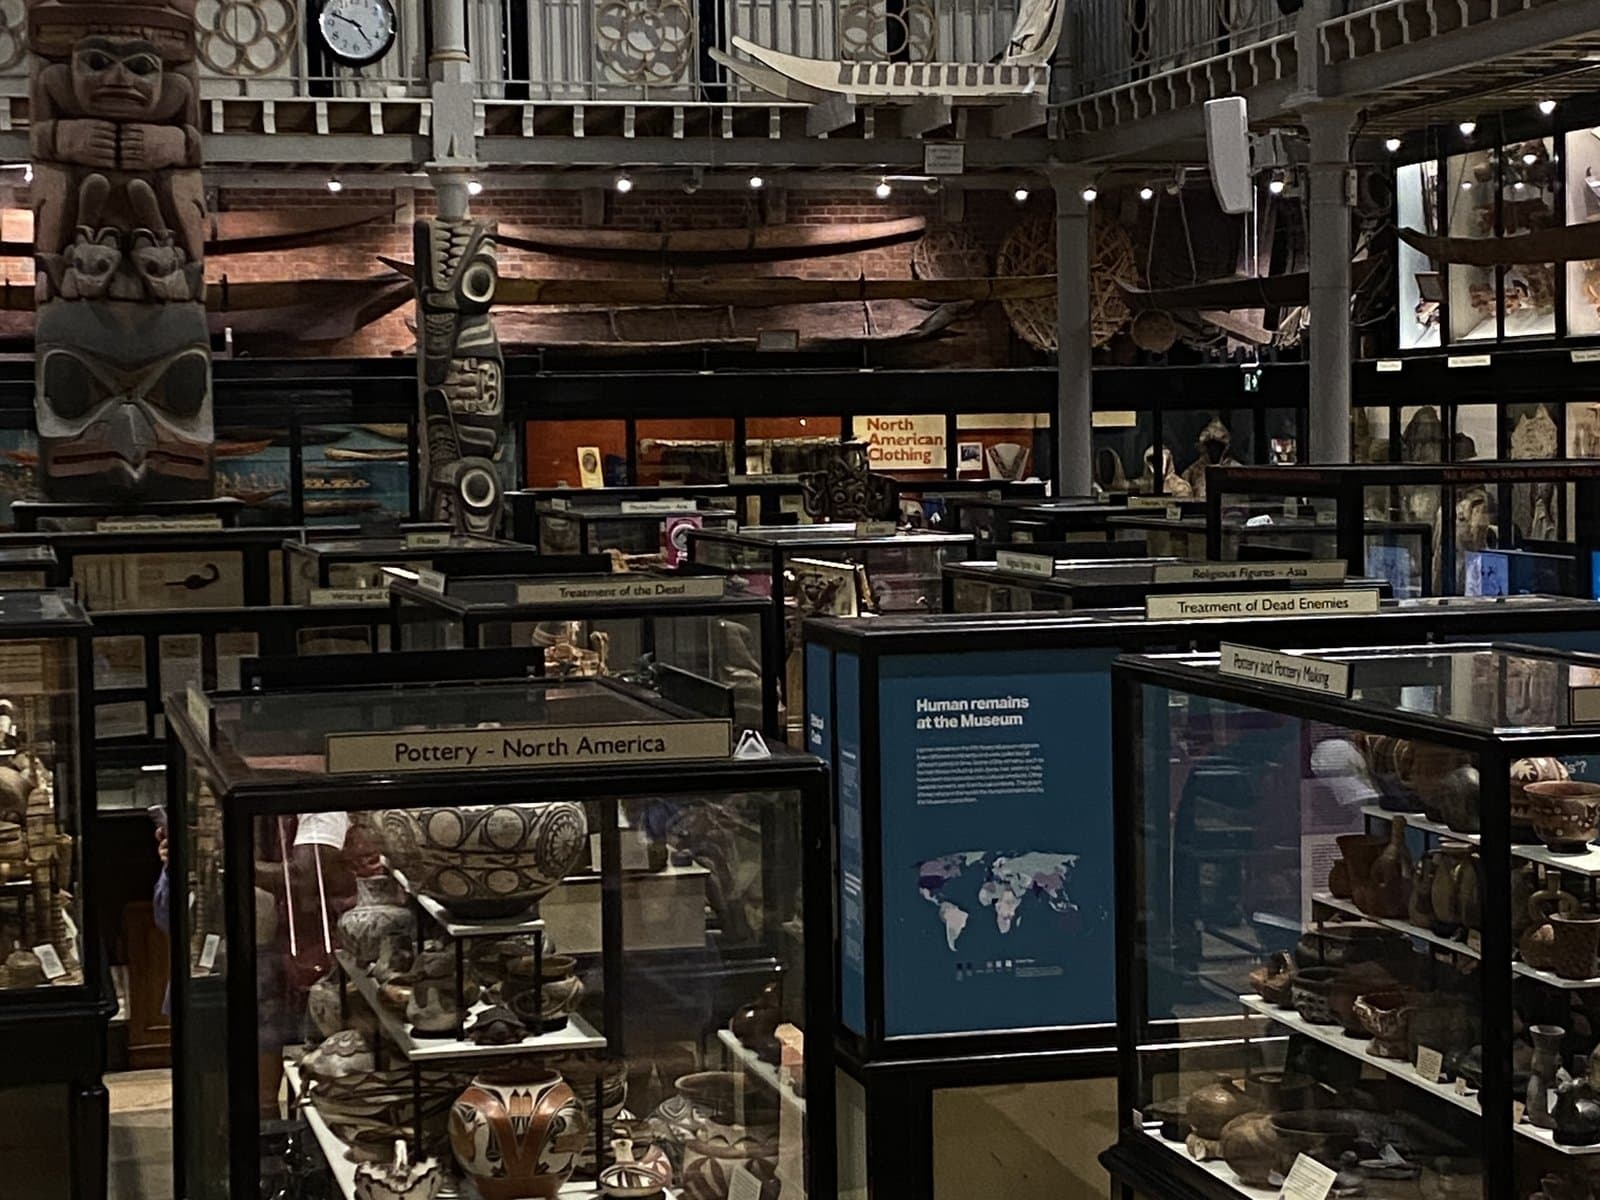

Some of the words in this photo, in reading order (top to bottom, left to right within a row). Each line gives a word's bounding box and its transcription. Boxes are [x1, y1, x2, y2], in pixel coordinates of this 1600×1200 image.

[867, 418, 914, 431] North
[869, 432, 943, 446] American
[868, 448, 932, 465] Clothing
[1240, 567, 1275, 580] Figures
[1286, 567, 1308, 577] Asia
[559, 586, 616, 598] Treatment
[619, 585, 631, 597] of
[634, 584, 651, 596] the
[655, 583, 686, 595] Dead
[1177, 600, 1242, 614] Treatment
[1245, 599, 1259, 612] of
[1262, 598, 1295, 612] Dead
[1299, 597, 1350, 611] Enemies
[1233, 653, 1259, 676] Pottery
[1260, 660, 1274, 675] and
[1274, 660, 1301, 684] Pottery
[916, 697, 969, 712] Human
[970, 696, 1030, 710] remains
[916, 716, 932, 729] at
[933, 714, 959, 729] the
[960, 713, 1024, 728] Museum
[395, 742, 478, 765] Pottery
[503, 737, 569, 759] North
[577, 735, 666, 755] America
